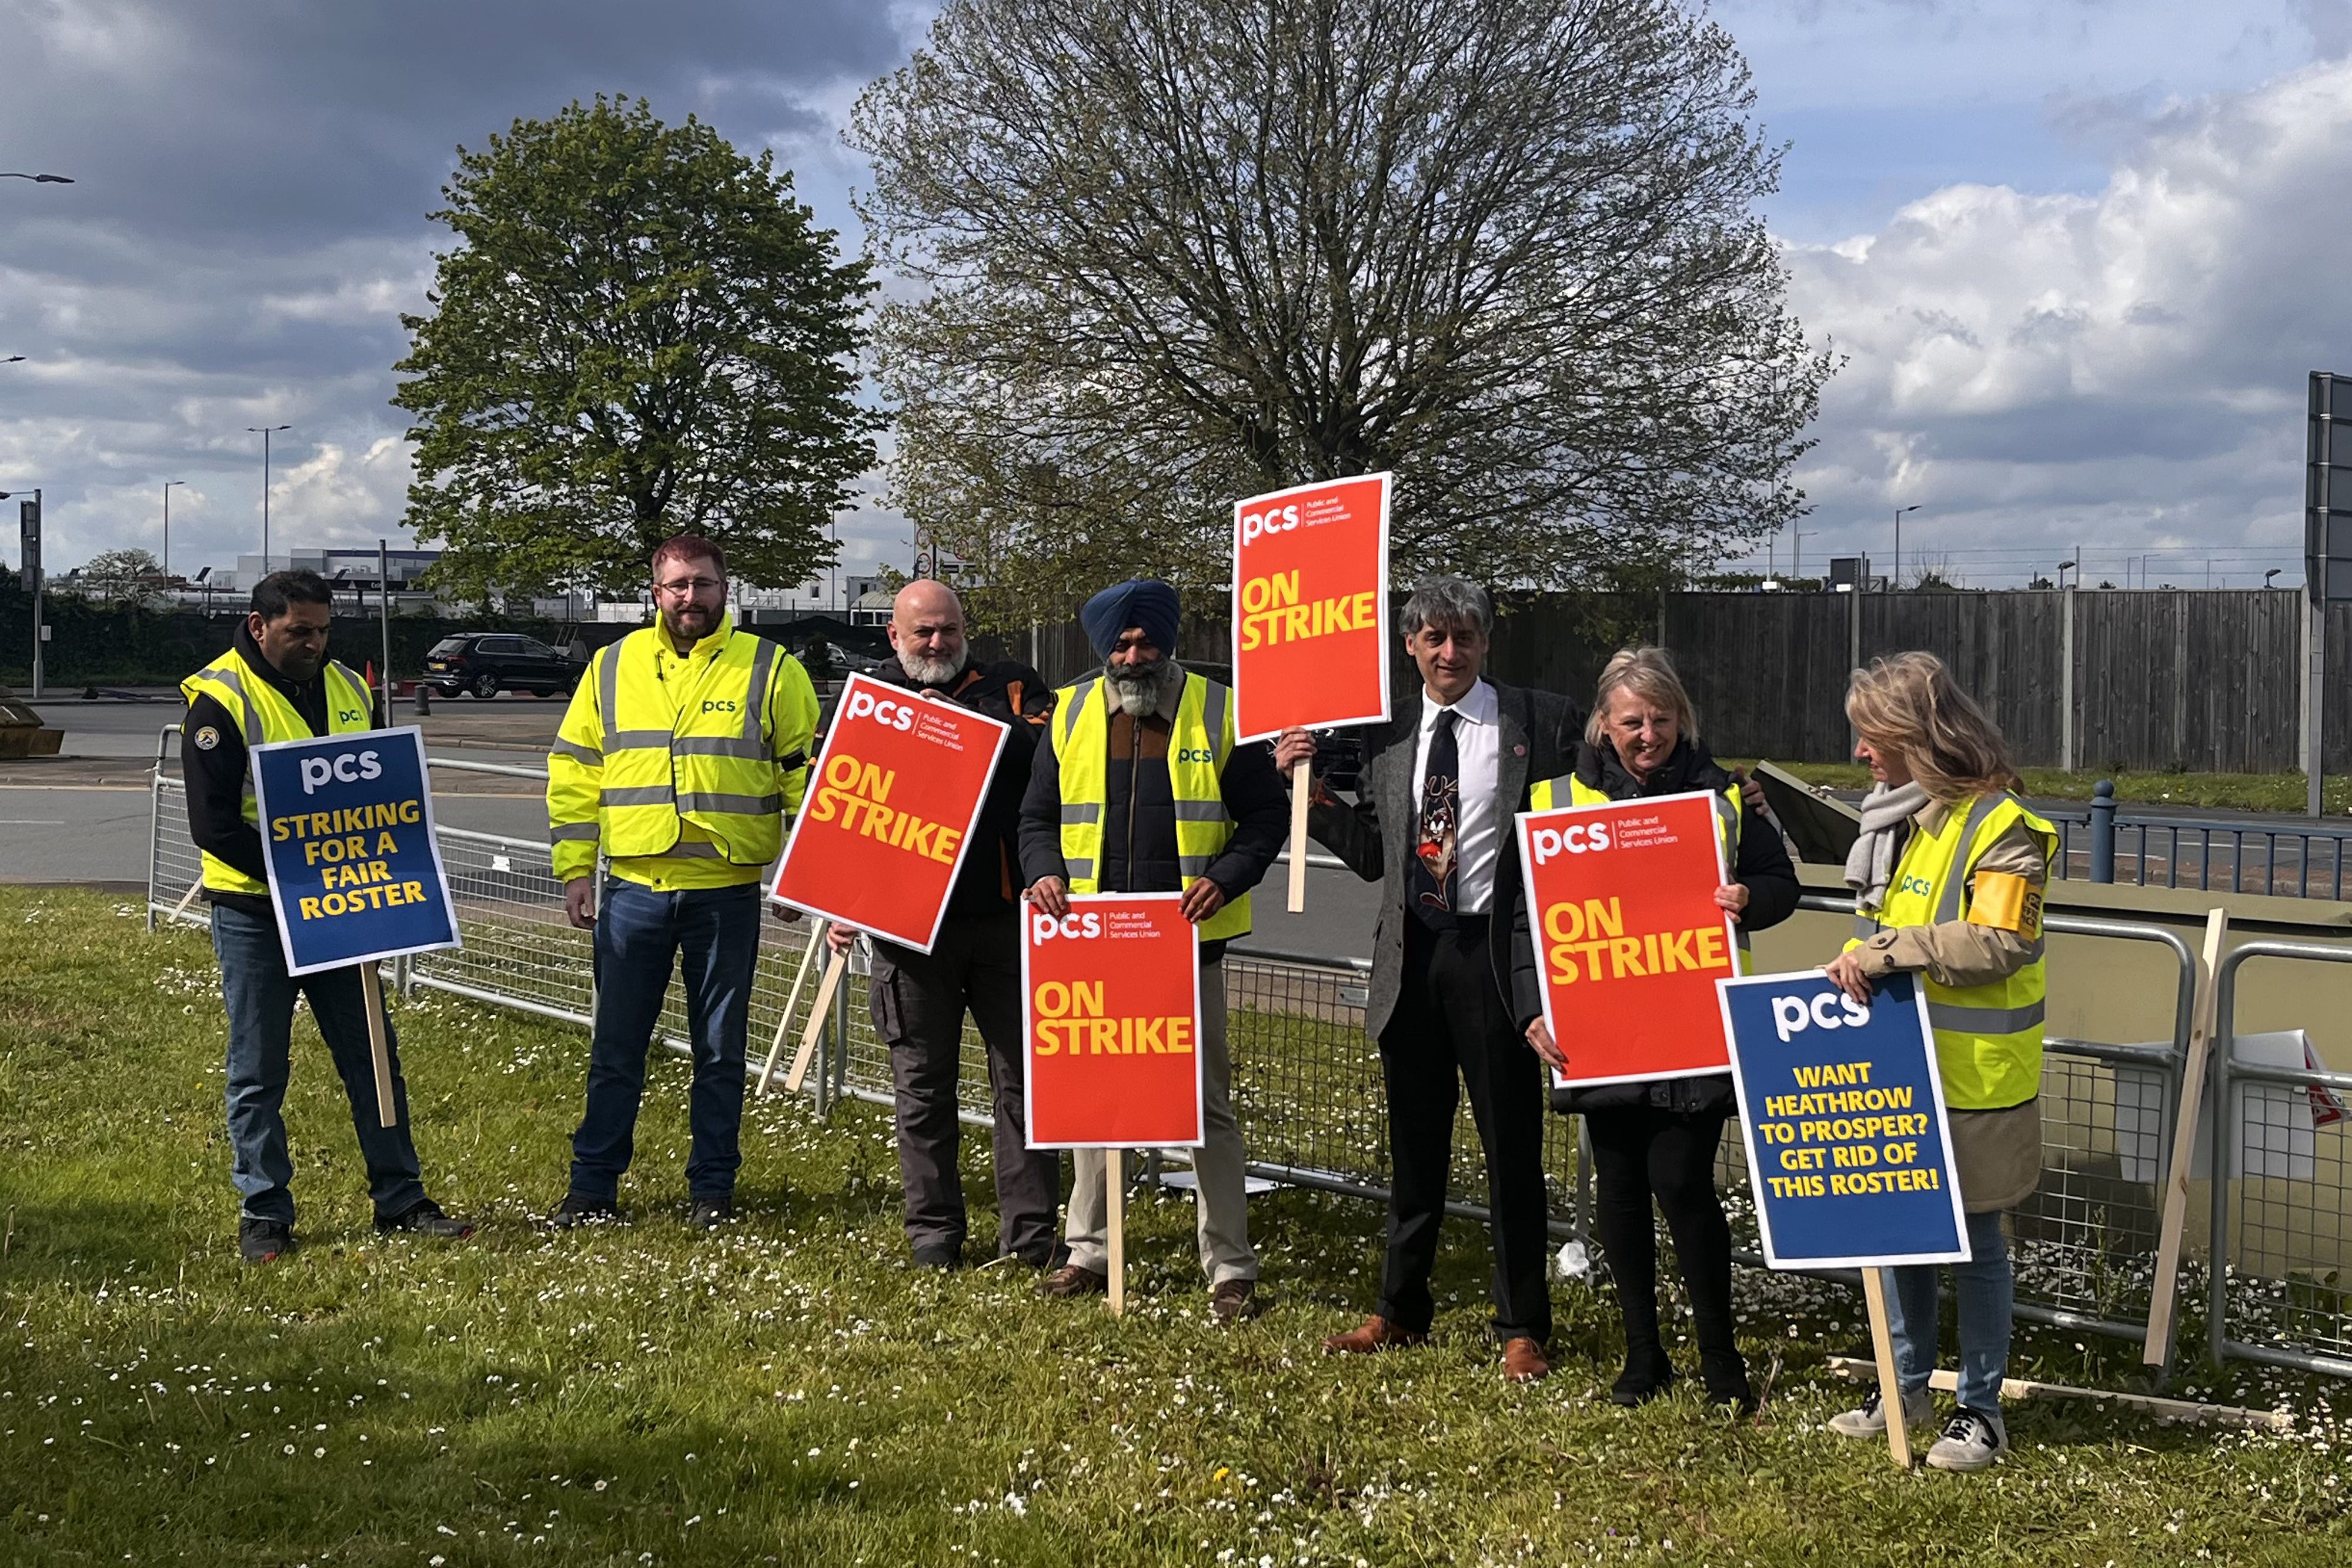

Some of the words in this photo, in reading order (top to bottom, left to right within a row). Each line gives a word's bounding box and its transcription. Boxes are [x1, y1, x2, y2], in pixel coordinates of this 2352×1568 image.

[1305, 505, 1344, 517] Commercial
[1307, 499, 1325, 508] Public
[1326, 496, 1338, 505] and
[1242, 505, 1299, 547] pcs
[1305, 516, 1331, 527] Services
[1332, 513, 1351, 521] Union
[584, 589, 593, 601] D
[1242, 569, 1299, 614] ON
[1241, 591, 1376, 651] STRIKE
[702, 700, 736, 714] pcs
[846, 690, 914, 731] pcs
[923, 713, 942, 726] Public
[943, 721, 957, 730] and
[916, 730, 944, 745] Services
[944, 740, 964, 751] Union
[920, 722, 960, 740] Commercial
[300, 750, 382, 794] pcs
[1179, 748, 1212, 764] pcs
[826, 754, 896, 804] ON
[272, 800, 420, 841] STRIKING
[810, 787, 961, 865] STRIKE
[1618, 817, 1641, 828] Public
[1643, 815, 1659, 825] and
[1619, 825, 1666, 838] Commercial
[304, 836, 368, 866] FOR
[377, 831, 398, 855] A
[1532, 822, 1610, 865] pcs
[1621, 837, 1653, 849] Services
[1653, 834, 1678, 845] Union
[321, 860, 393, 890] FAIR
[1900, 875, 1930, 896] pcs
[299, 881, 427, 920] ROSTER
[1033, 912, 1100, 946] pcs
[1109, 930, 1138, 938] Services
[1140, 930, 1161, 938] Union
[1544, 896, 1623, 943] ON
[1549, 927, 1729, 985] STRIKE
[1035, 981, 1104, 1018] ON
[1771, 992, 1870, 1042] pcs
[1035, 1017, 1193, 1055] STRIKE
[1792, 1061, 1872, 1088] WANT
[1765, 1086, 1913, 1118] HEATHROW
[1759, 1122, 1795, 1145] TO
[1799, 1113, 1929, 1142] PROSPER?
[1780, 1148, 1826, 1171] GET
[1832, 1145, 1878, 1168] RID
[1883, 1142, 1917, 1165] OF
[1767, 1175, 1826, 1198] THIS
[1830, 1168, 1939, 1196] ROSTER!
